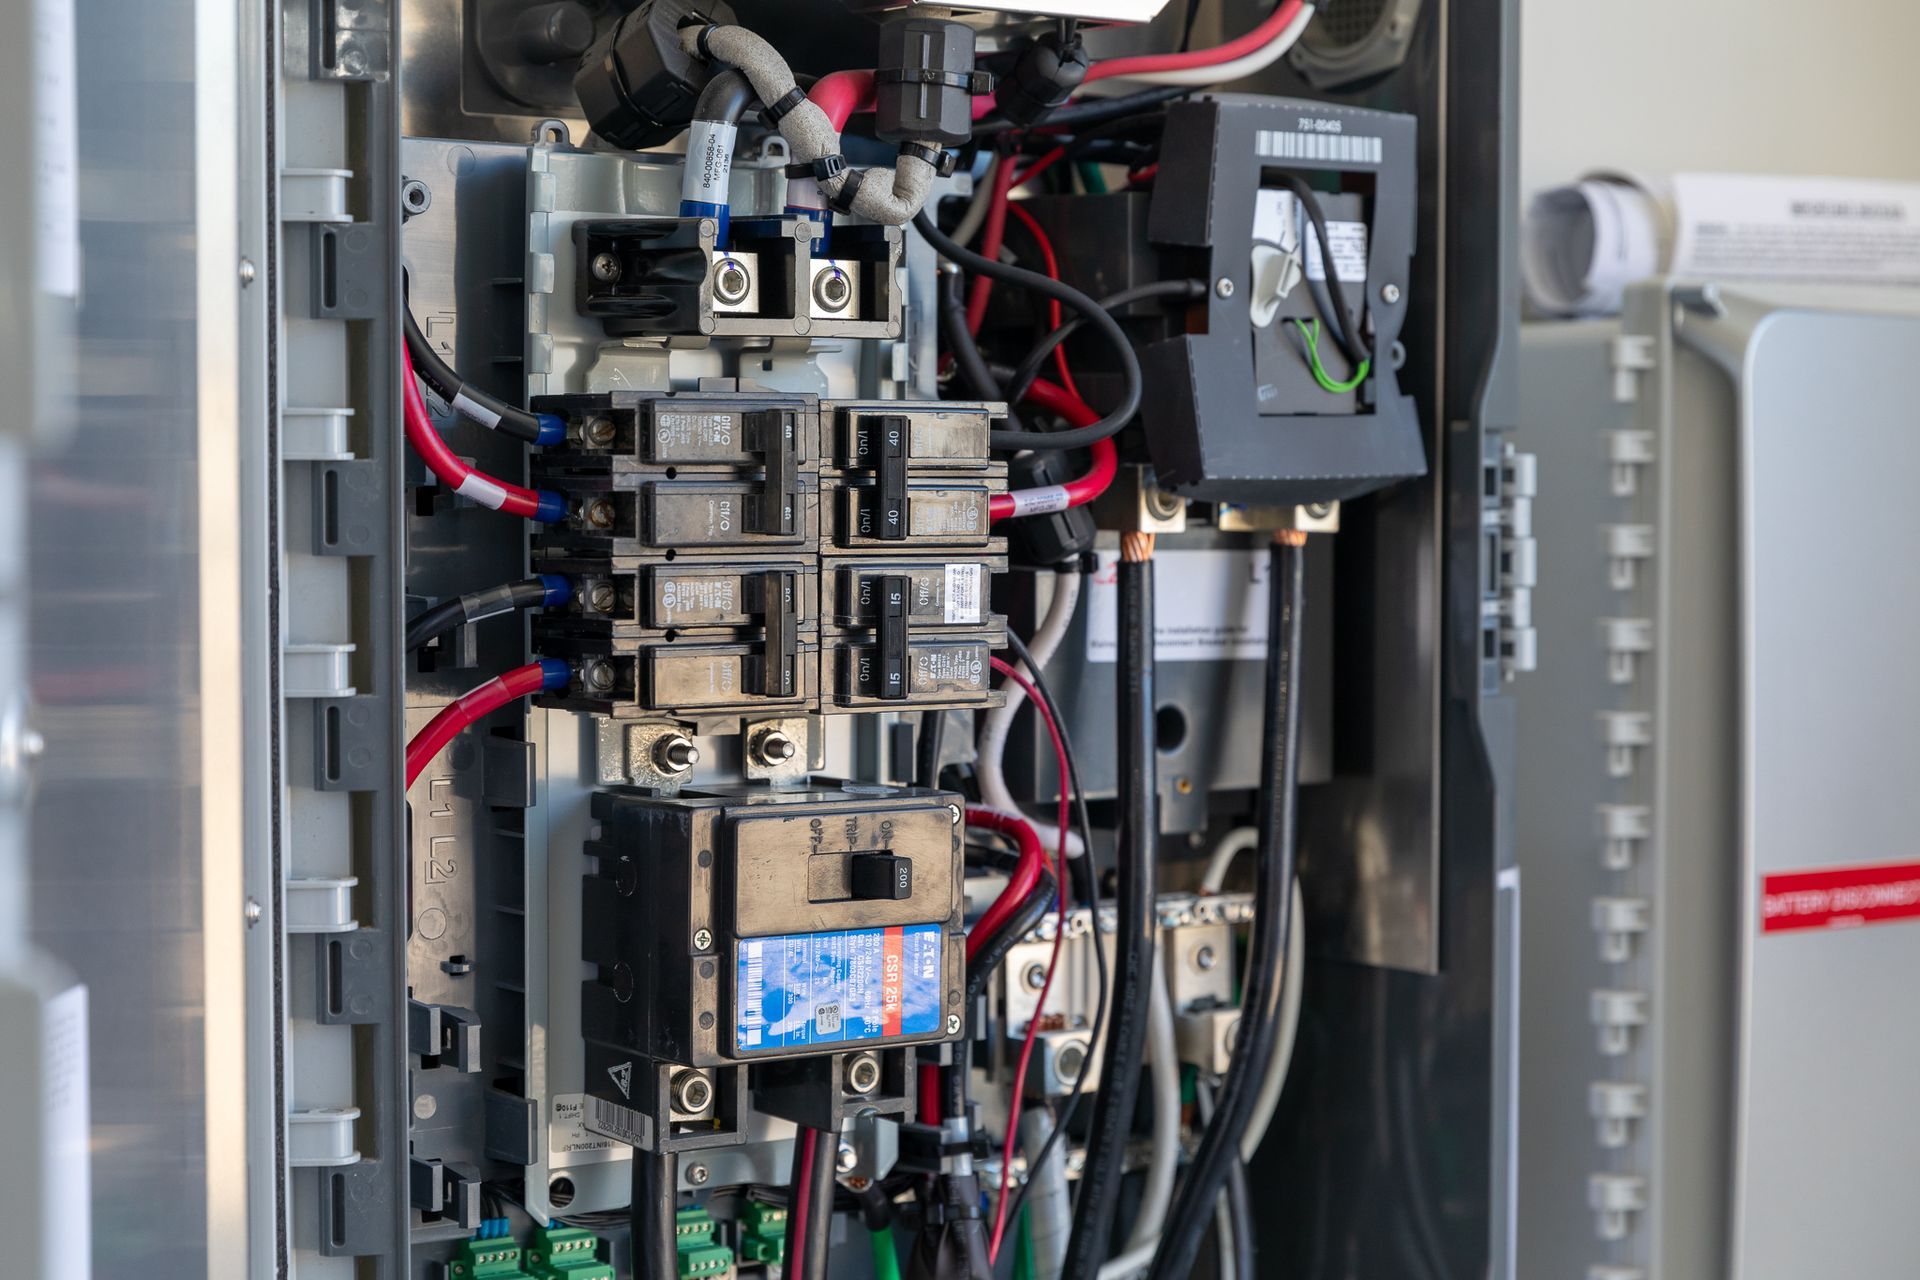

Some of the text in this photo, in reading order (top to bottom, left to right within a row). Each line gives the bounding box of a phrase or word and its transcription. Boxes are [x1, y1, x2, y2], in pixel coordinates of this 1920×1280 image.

[703, 134, 715, 188] 840-00858-04
[714, 145, 723, 180] MFG-061
[889, 431, 898, 446] 40
[888, 510, 898, 525] 40
[891, 593, 901, 604] 15
[890, 673, 900, 684] 15
[430, 780, 457, 879] L1 L2
[810, 818, 824, 844] OFF
[846, 816, 858, 845] TRIP
[881, 821, 893, 839] ON
[900, 868, 908, 888] 200
[923, 931, 935, 978] EATON
[886, 954, 898, 1011] CSR 25k
